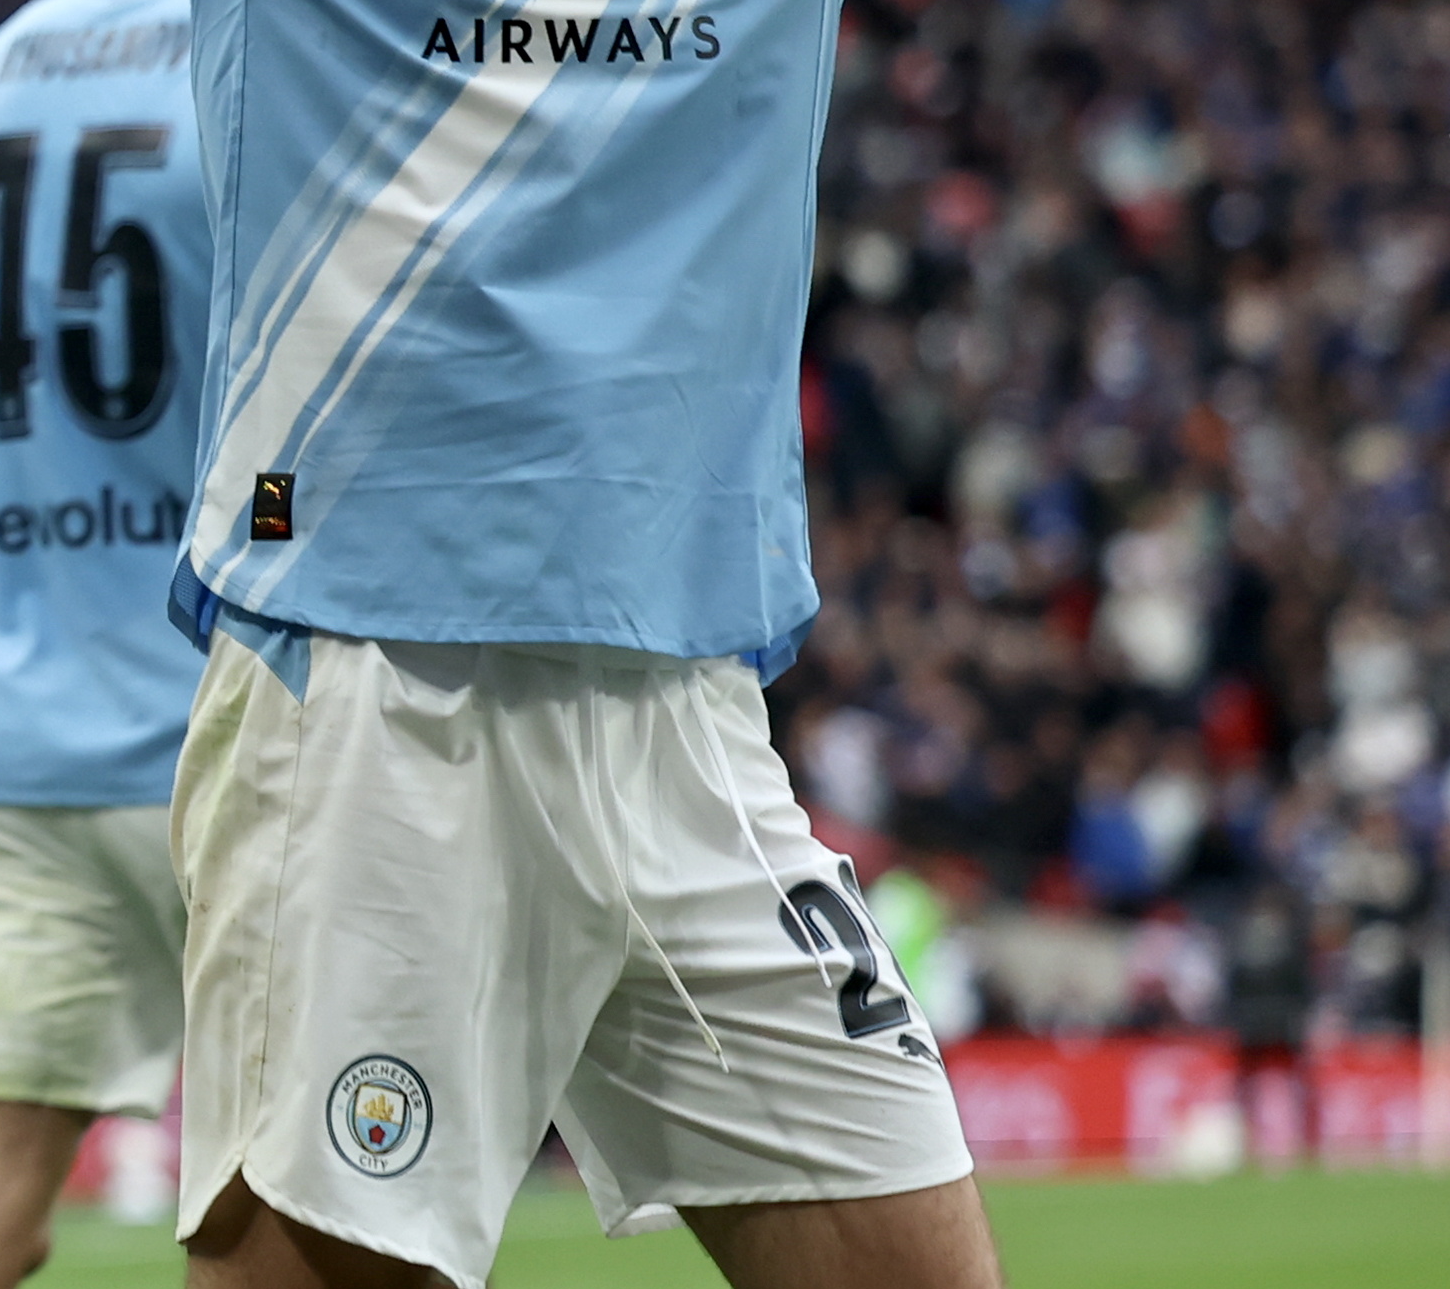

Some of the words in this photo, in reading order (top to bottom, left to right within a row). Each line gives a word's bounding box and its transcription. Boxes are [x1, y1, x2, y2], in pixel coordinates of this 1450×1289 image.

[421, 15, 722, 65] AIRWAYS
[777, 859, 914, 1040] 2
[341, 1063, 423, 1111] MANCHESTER
[358, 1153, 389, 1172] CITY
